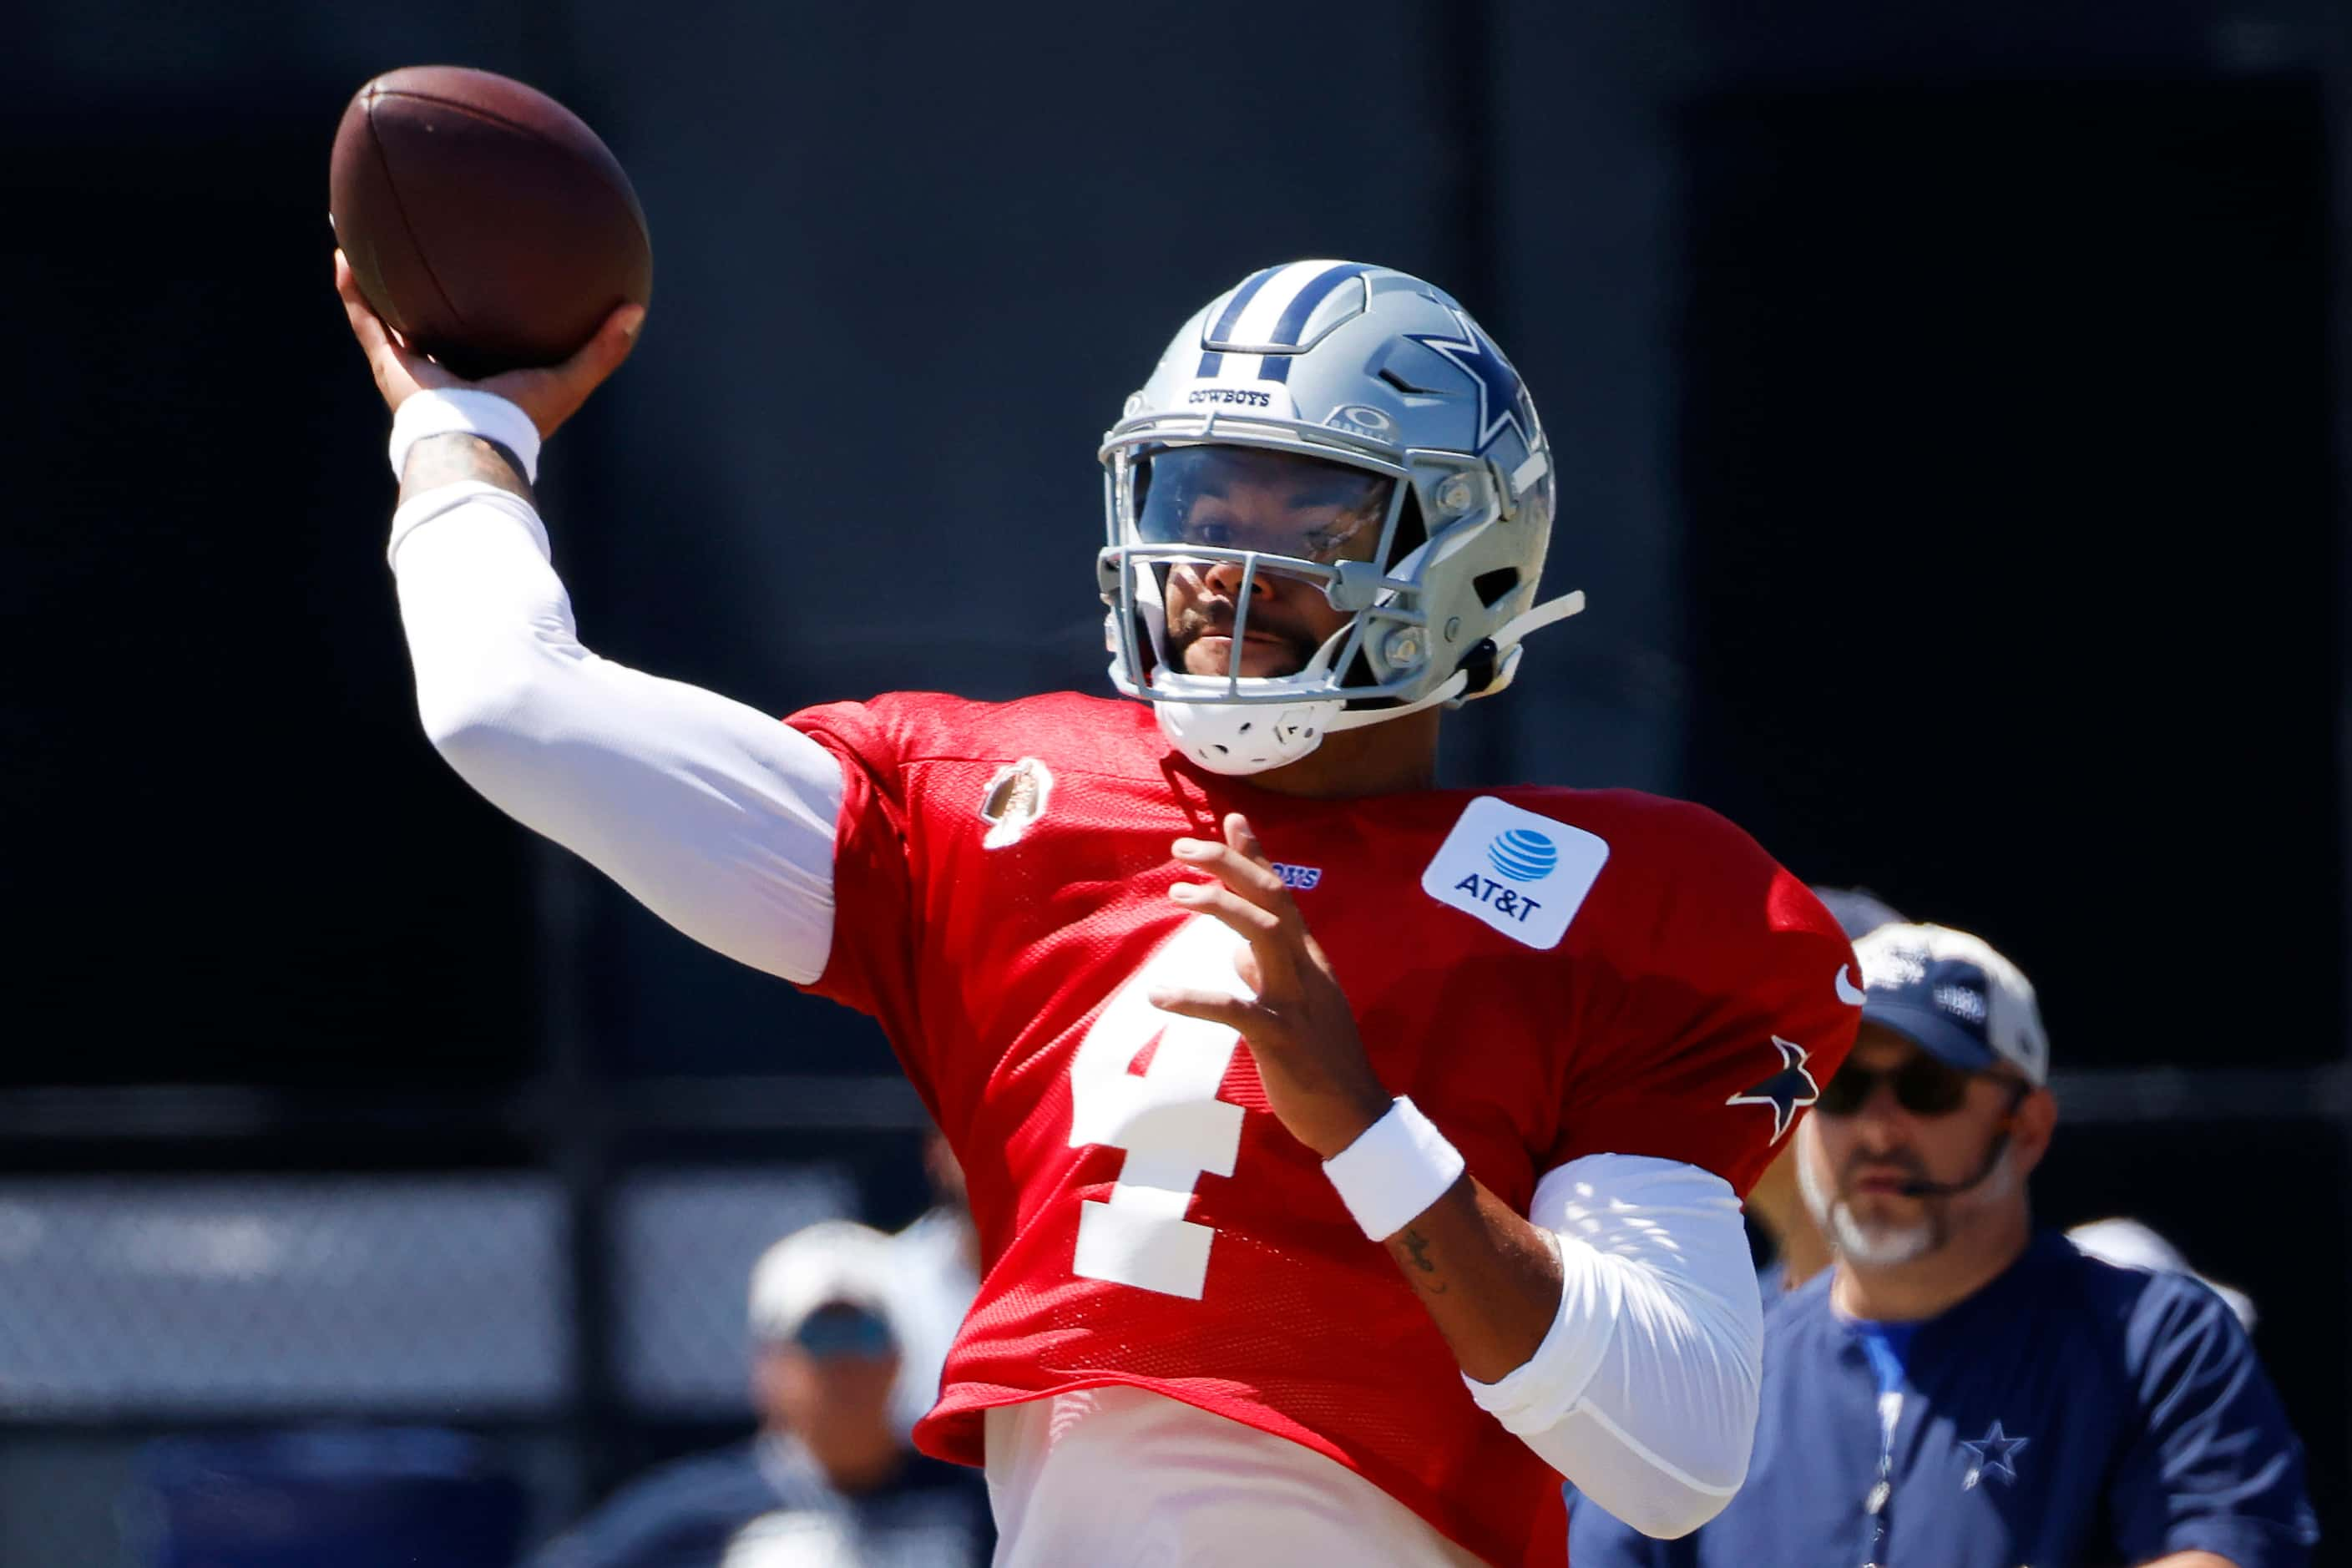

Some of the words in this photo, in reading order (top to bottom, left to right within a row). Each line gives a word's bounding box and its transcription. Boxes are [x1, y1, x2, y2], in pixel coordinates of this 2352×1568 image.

[1188, 388, 1271, 407] COWBOYS
[1454, 873, 1541, 922] AT&T
[1070, 913, 1259, 1300] 4
